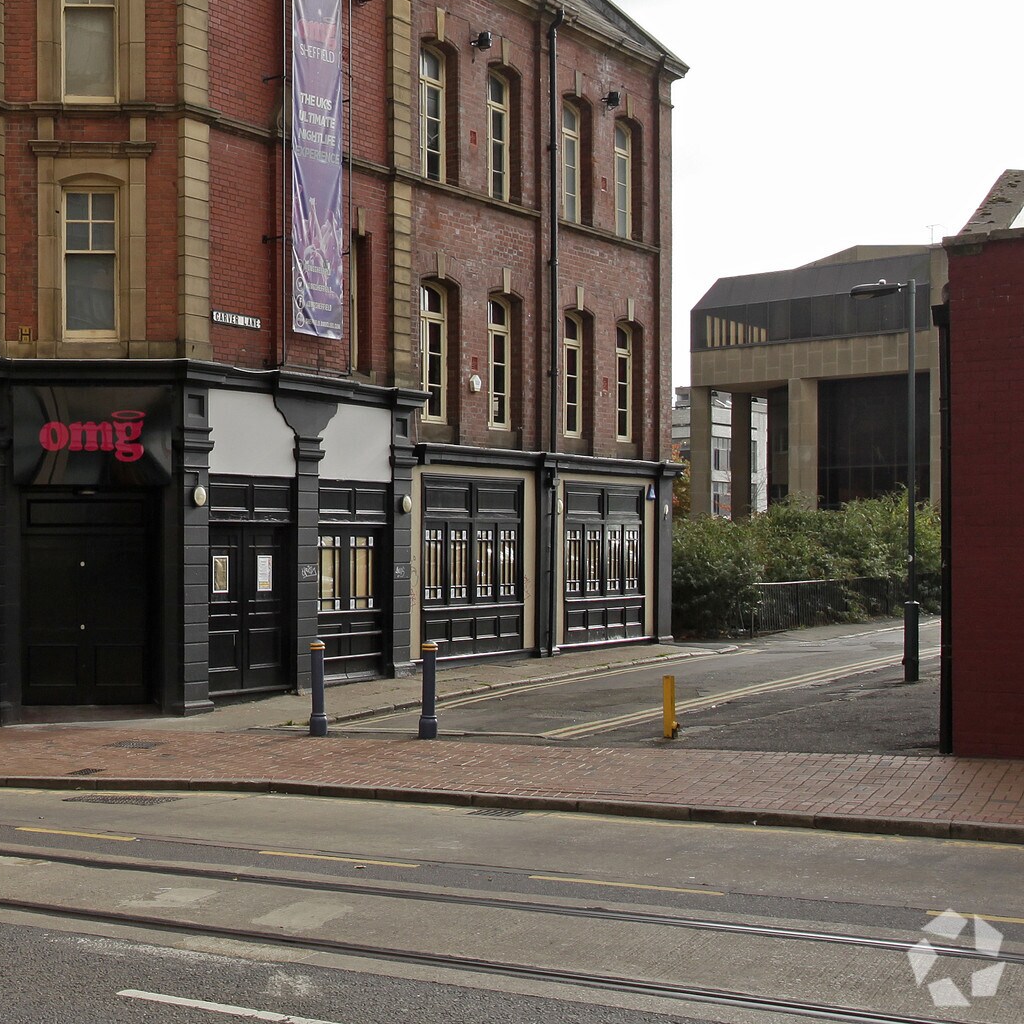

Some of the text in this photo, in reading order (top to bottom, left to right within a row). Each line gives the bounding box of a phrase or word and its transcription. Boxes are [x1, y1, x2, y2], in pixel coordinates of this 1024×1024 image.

[300, 44, 335, 63] SHEFFIELD
[300, 92, 315, 106] THE
[298, 109, 336, 129] ULTIMATE
[298, 128, 336, 146] NIGHTLIFE
[296, 145, 340, 165] EXPERIENCE
[215, 312, 260, 328] CARVER LANE
[39, 420, 144, 462] omg
